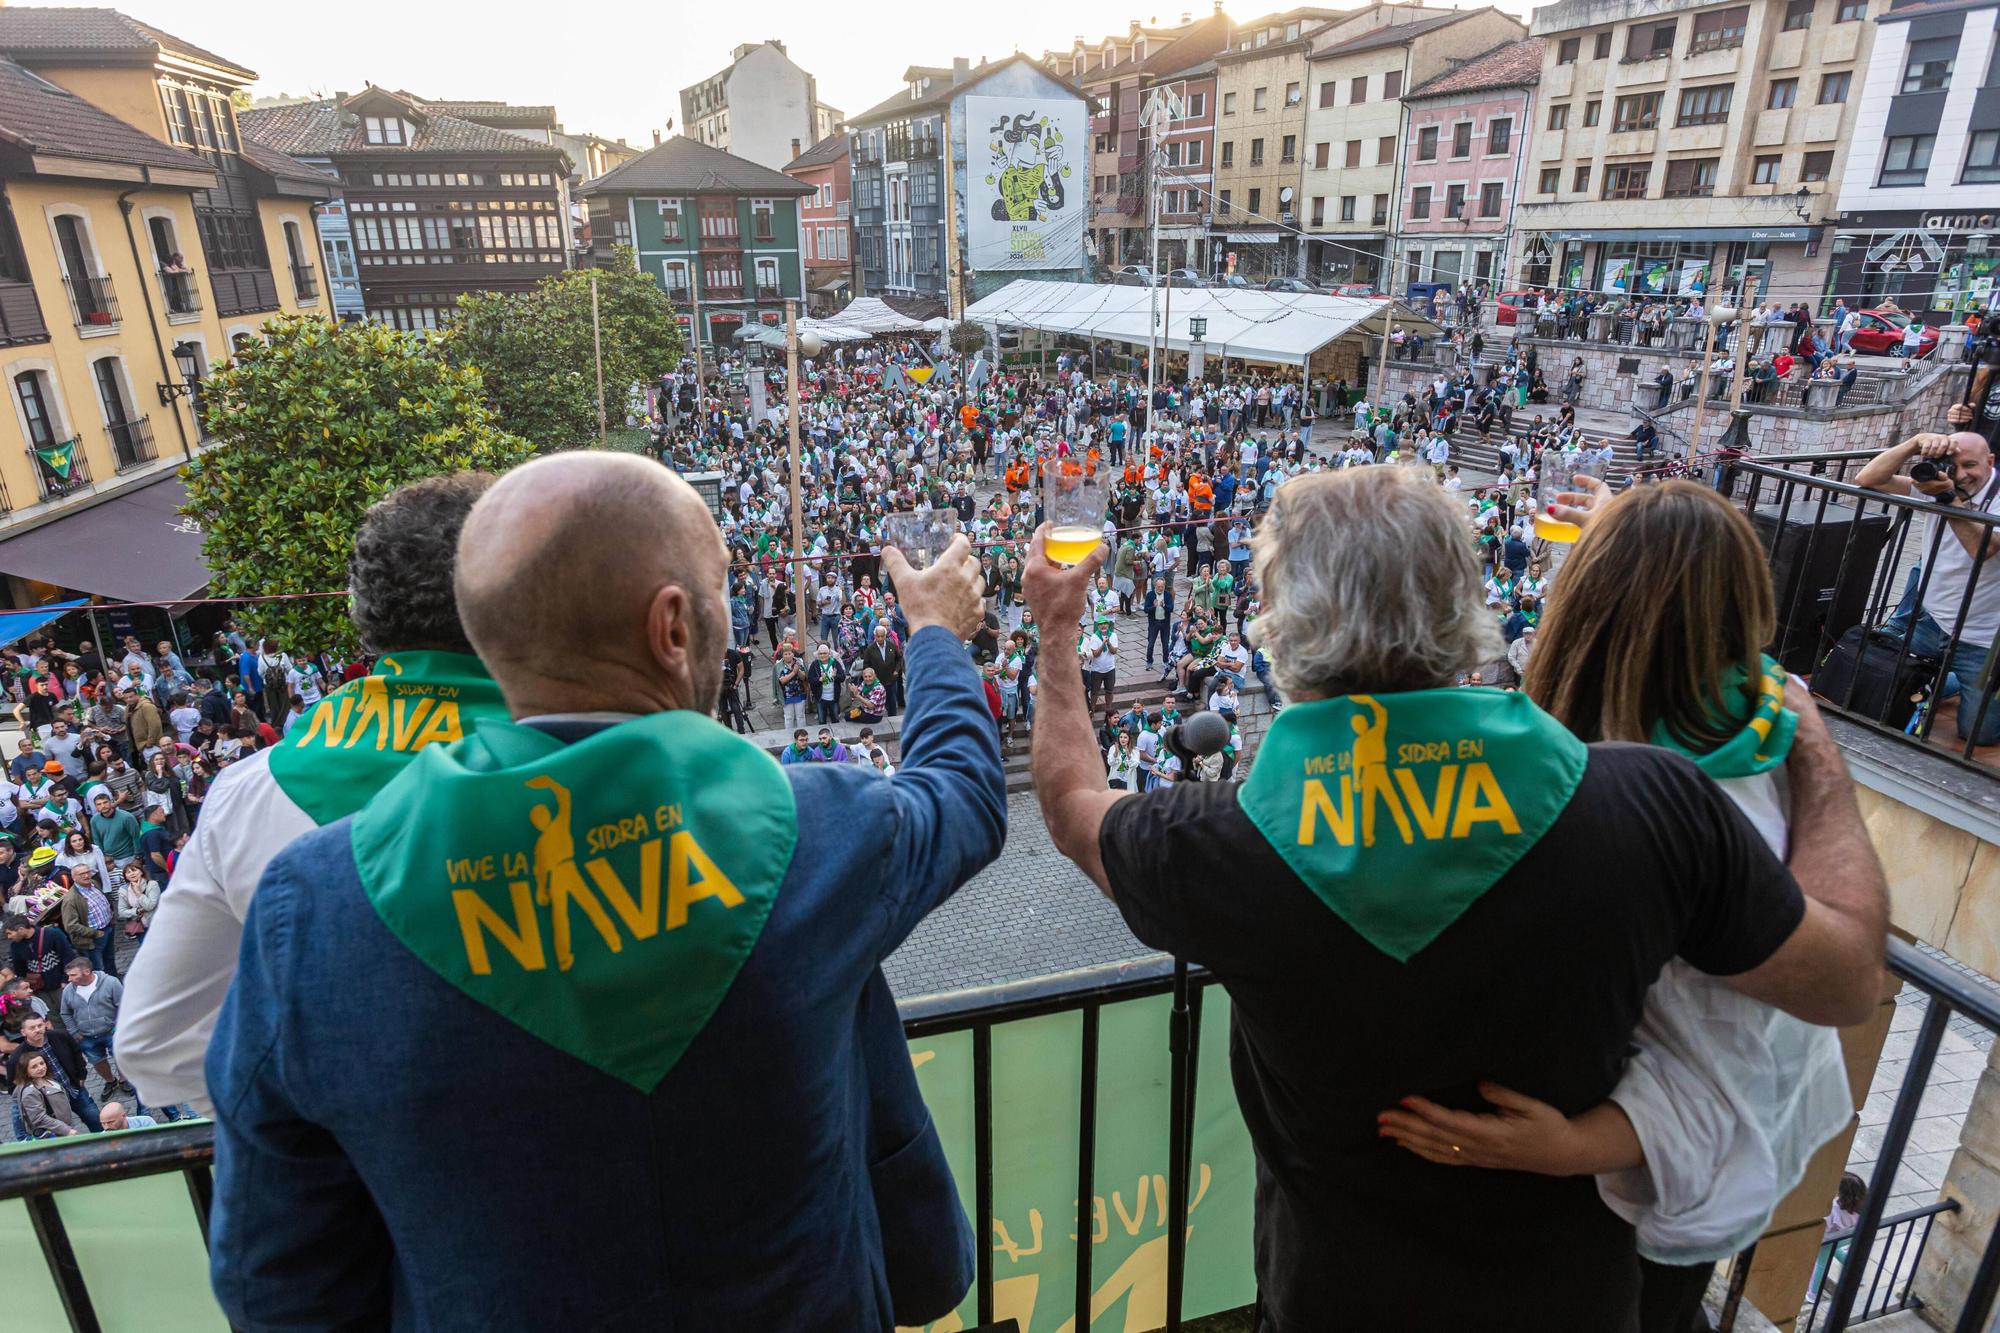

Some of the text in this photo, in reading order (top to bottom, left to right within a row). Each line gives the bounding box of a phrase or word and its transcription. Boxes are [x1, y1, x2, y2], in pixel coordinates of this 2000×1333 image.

[296, 696, 464, 751] NAVA
[1303, 738, 1484, 776] VIVE LA SIDRA EN
[446, 801, 684, 885] VIVE LA SIDRA EN
[1297, 762, 1524, 848] NAVA
[451, 830, 747, 976] NAVA
